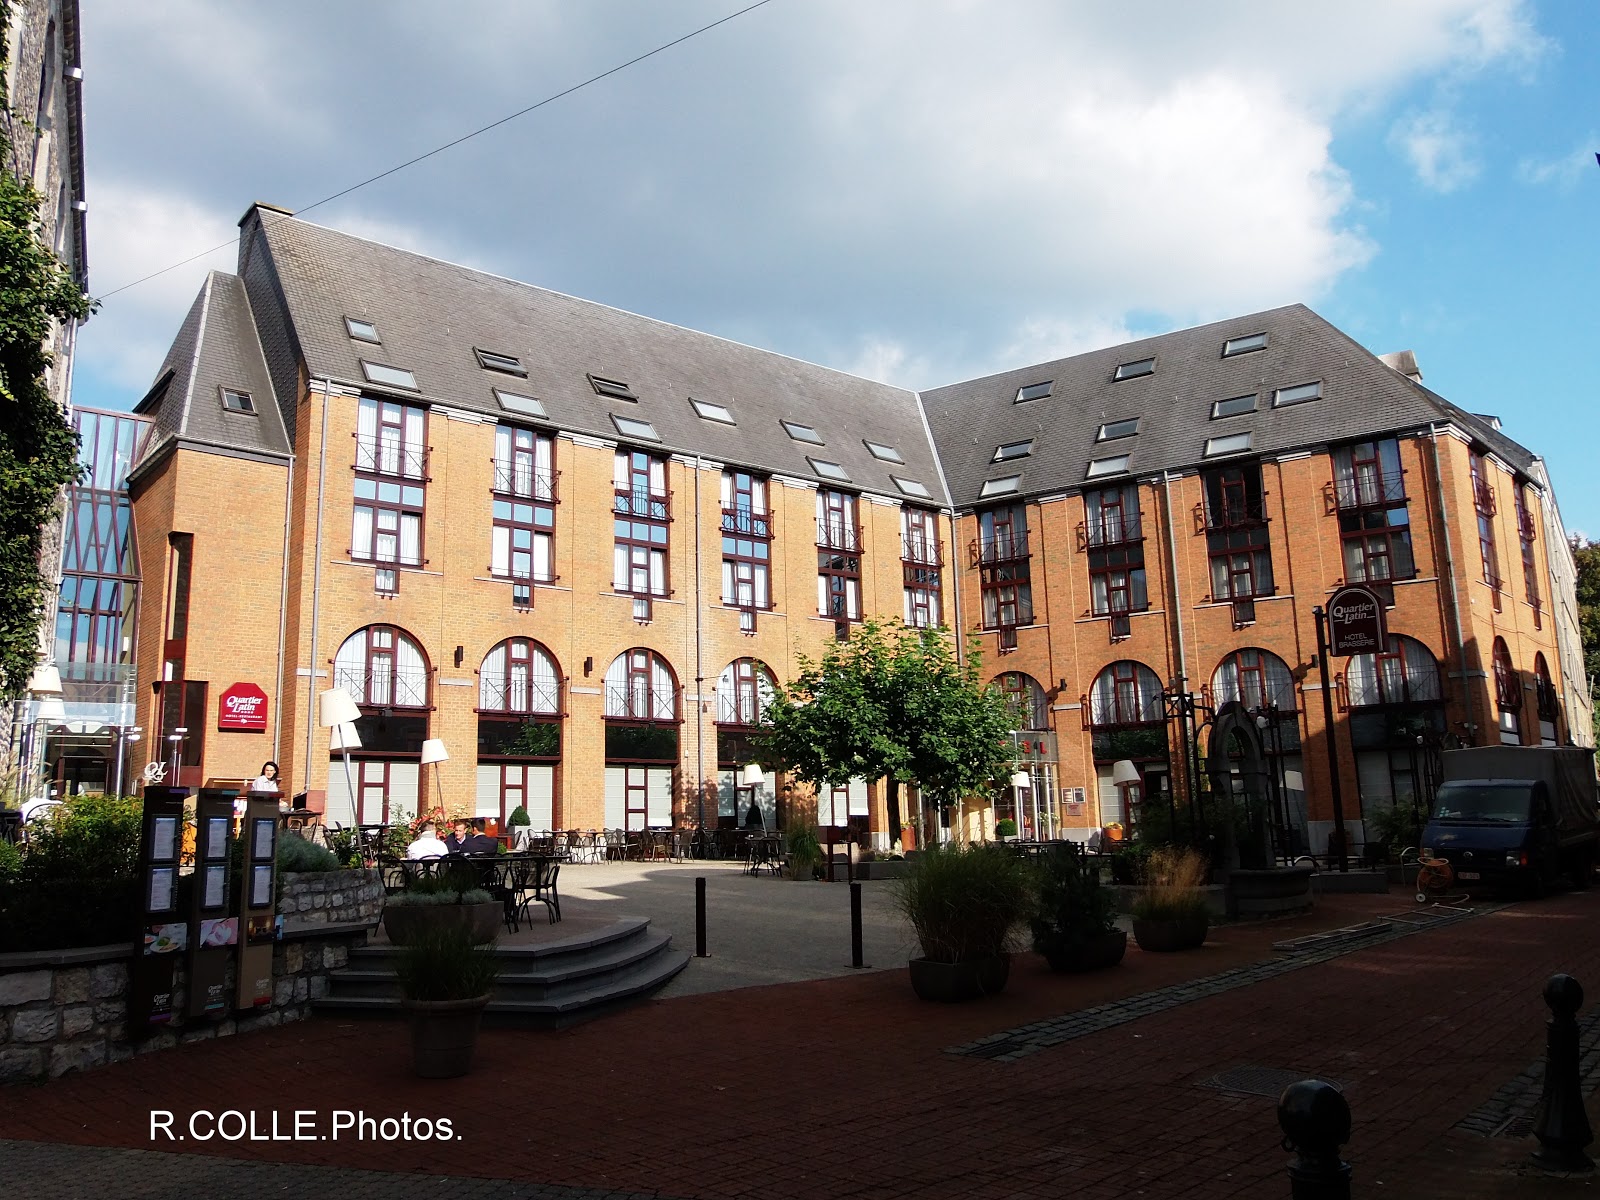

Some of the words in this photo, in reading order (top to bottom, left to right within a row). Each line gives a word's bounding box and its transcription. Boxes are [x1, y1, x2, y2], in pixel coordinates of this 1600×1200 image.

[1333, 603, 1374, 617] Quartier
[1344, 612, 1367, 624] Latin
[1339, 639, 1375, 648] BRASSERIE
[226, 695, 263, 707] Quartier
[232, 703, 255, 712] Latin
